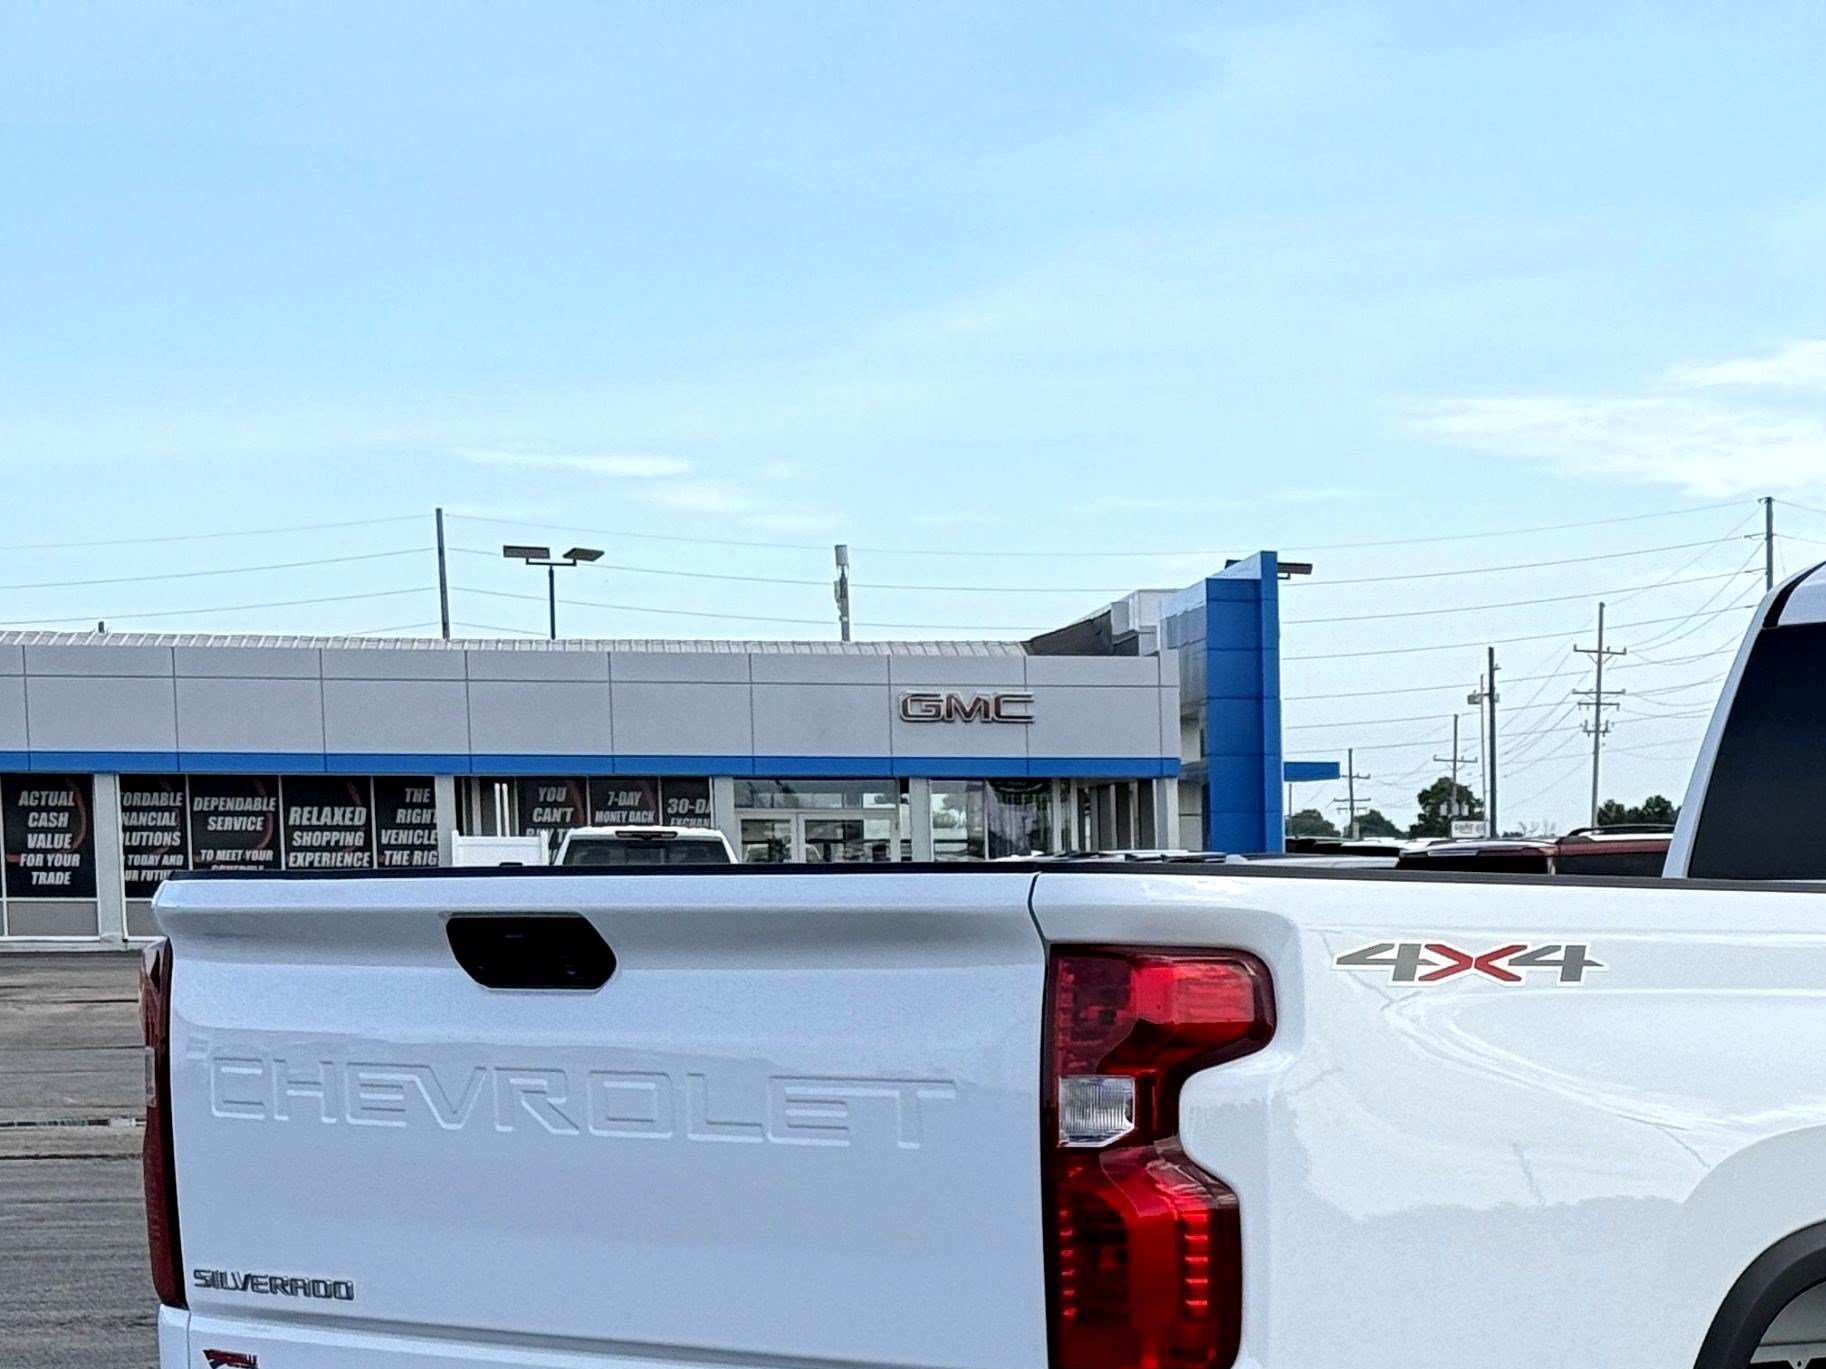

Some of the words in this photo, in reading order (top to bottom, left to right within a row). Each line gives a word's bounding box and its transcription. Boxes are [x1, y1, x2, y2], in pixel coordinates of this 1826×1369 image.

[898, 690, 1035, 724] GMC
[18, 790, 75, 807] ACTUAL
[405, 788, 431, 803] THE
[538, 787, 567, 802] YOU
[607, 791, 642, 806] 7-DAY
[193, 796, 277, 812] DEPENDABLE
[28, 812, 69, 828] CASH
[288, 806, 367, 826] RELAXED
[532, 807, 574, 823] CAN'T
[595, 810, 627, 823] MONEY
[629, 810, 655, 823] BACK
[207, 816, 265, 831] SERVICE
[27, 833, 72, 849] VALUE
[292, 831, 365, 847] SHOPPING
[19, 853, 46, 867] FOR
[47, 853, 80, 867] YOUR
[128, 854, 160, 867] TODAY
[162, 854, 184, 866] AND
[200, 849, 214, 861] TO
[215, 849, 243, 861] MEET
[245, 849, 274, 861] YOUR
[288, 851, 371, 868] EXPERIENCE
[384, 850, 410, 866] THE
[31, 871, 72, 885] TRADE
[208, 1056, 958, 1151] CHEVROLET
[193, 1269, 354, 1301] SILVERADO
